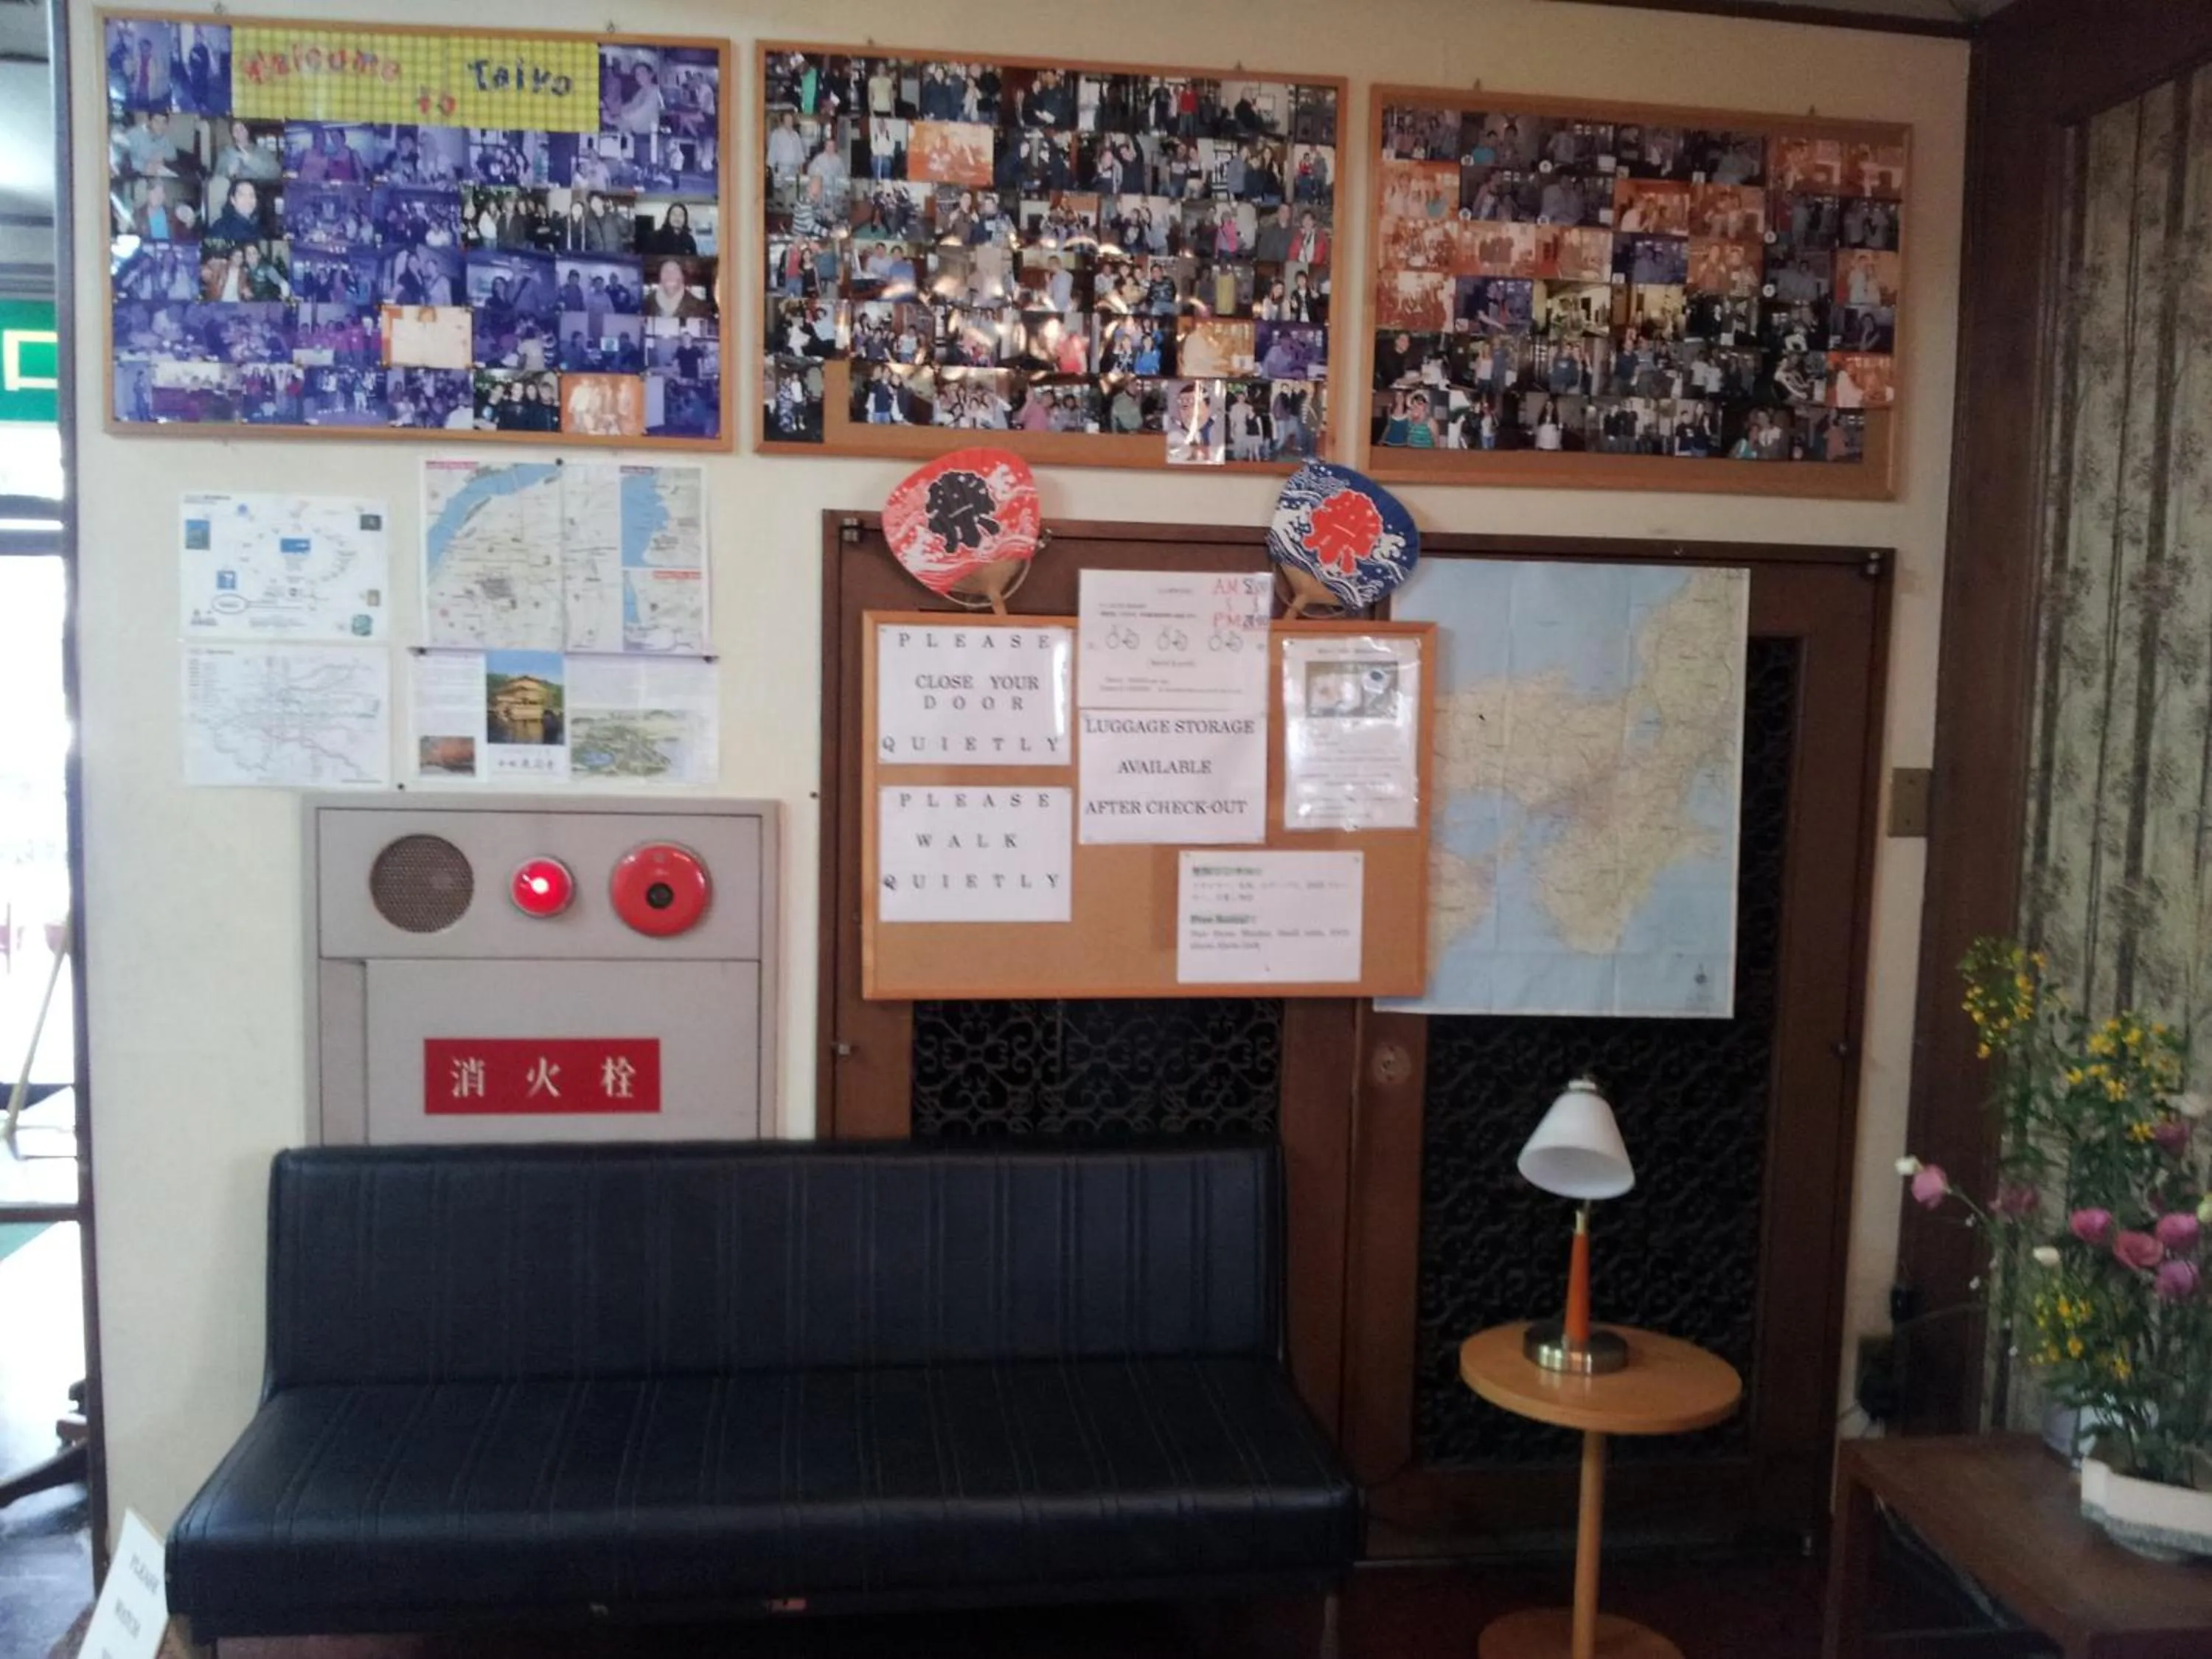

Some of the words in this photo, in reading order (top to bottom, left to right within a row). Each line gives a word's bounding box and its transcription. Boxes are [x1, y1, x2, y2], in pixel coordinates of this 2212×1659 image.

[898, 632, 1050, 650] PLEASE
[915, 674, 973, 690] CLOSE
[990, 675, 1040, 691] YOUR
[923, 695, 1024, 711] DOOR
[1086, 718, 1171, 734] LUGGAGE
[1174, 720, 1256, 734] STORAGE
[882, 736, 1058, 753] QUIETLY
[1118, 759, 1212, 774] AVAILABLE
[899, 793, 1050, 808] PLEASE
[1088, 800, 1142, 815] AFTER
[1146, 800, 1248, 815] CHECK-OUT
[916, 833, 1018, 849] WALK
[883, 873, 1060, 891] QUIETLY
[450, 1056, 637, 1099] 消火栓
